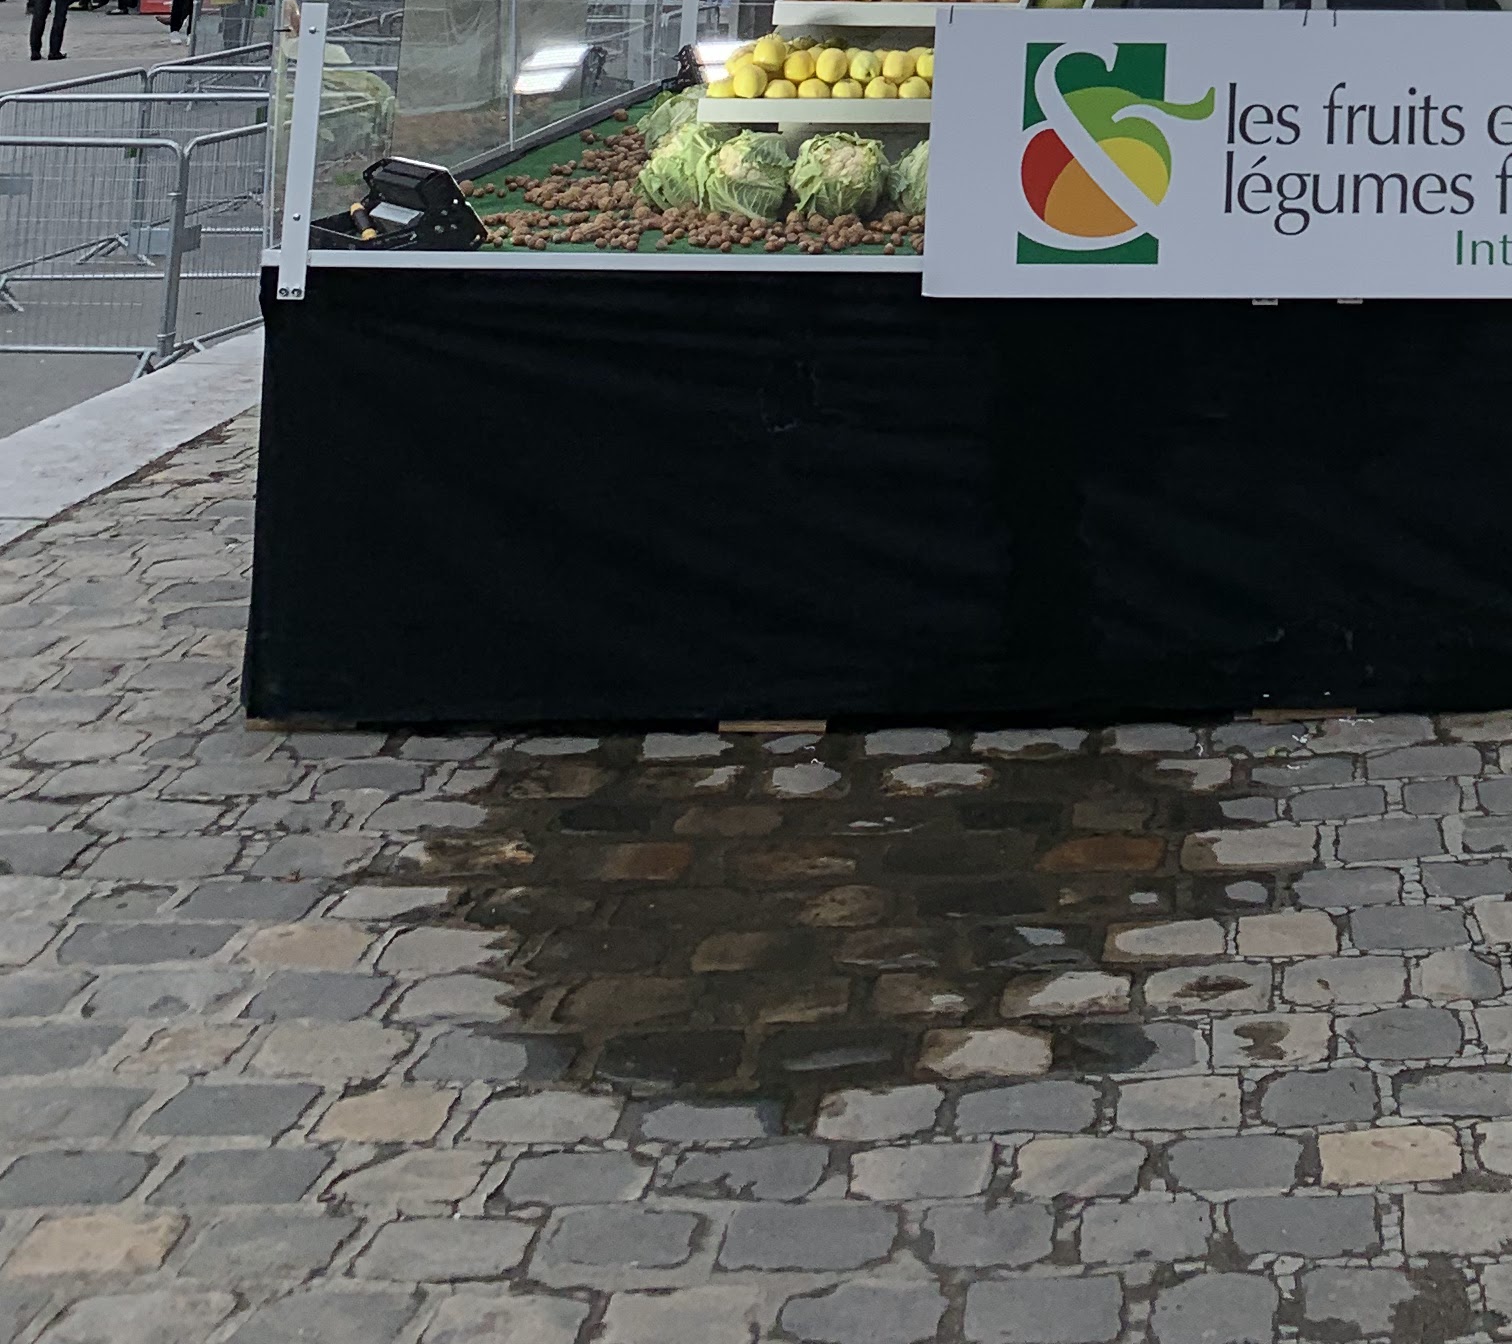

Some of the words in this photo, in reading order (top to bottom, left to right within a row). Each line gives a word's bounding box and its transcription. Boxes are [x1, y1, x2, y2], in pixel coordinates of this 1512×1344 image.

[1227, 83, 1302, 147] les
[1323, 82, 1467, 147] fruits
[1223, 151, 1476, 237] légumes
